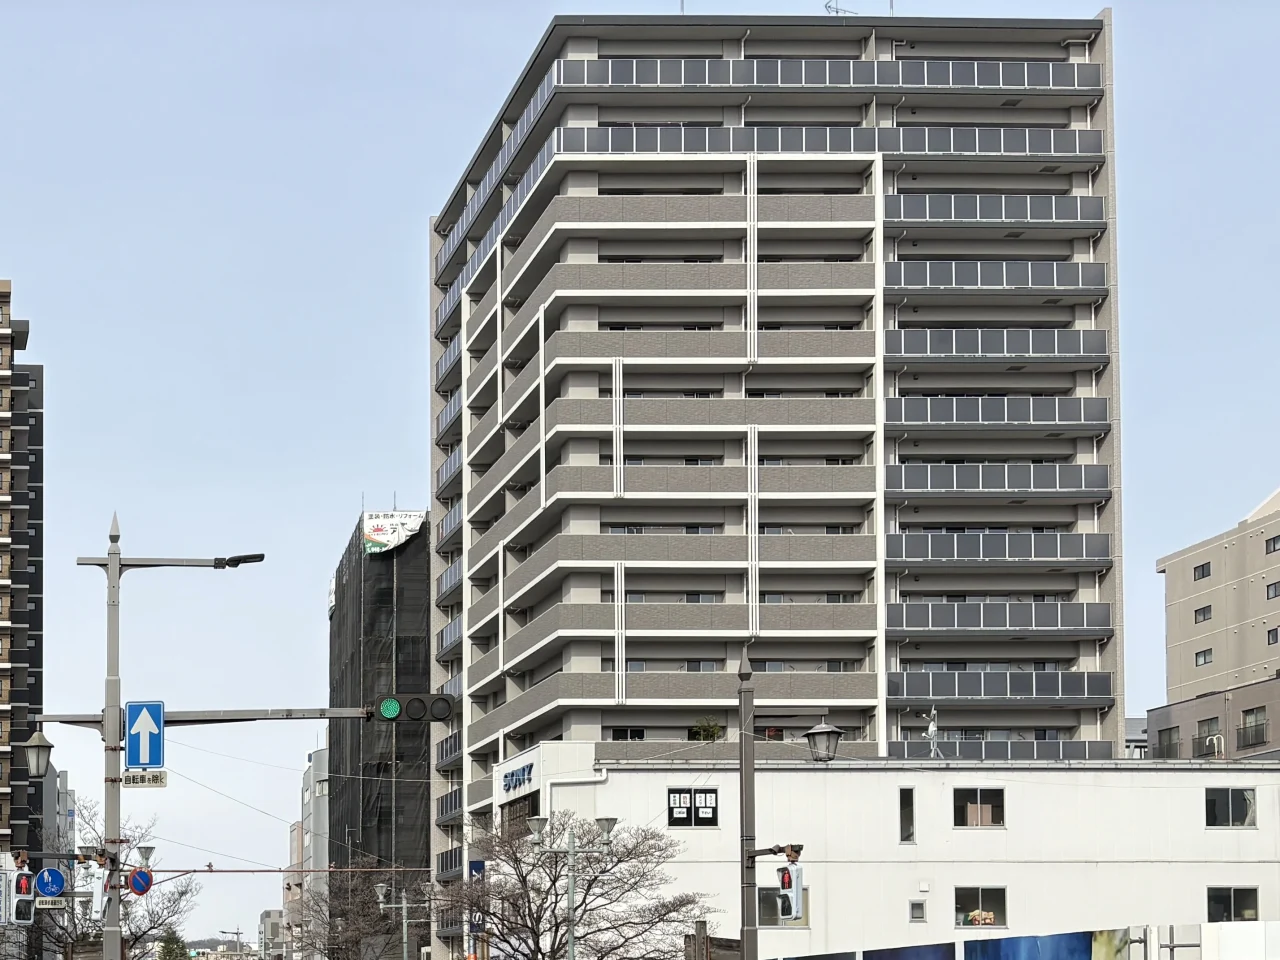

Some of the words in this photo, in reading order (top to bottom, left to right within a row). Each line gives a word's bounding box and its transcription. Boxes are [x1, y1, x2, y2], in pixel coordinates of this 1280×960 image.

[124, 774, 164, 785] 自転車を除く
[503, 763, 534, 792] SONY
